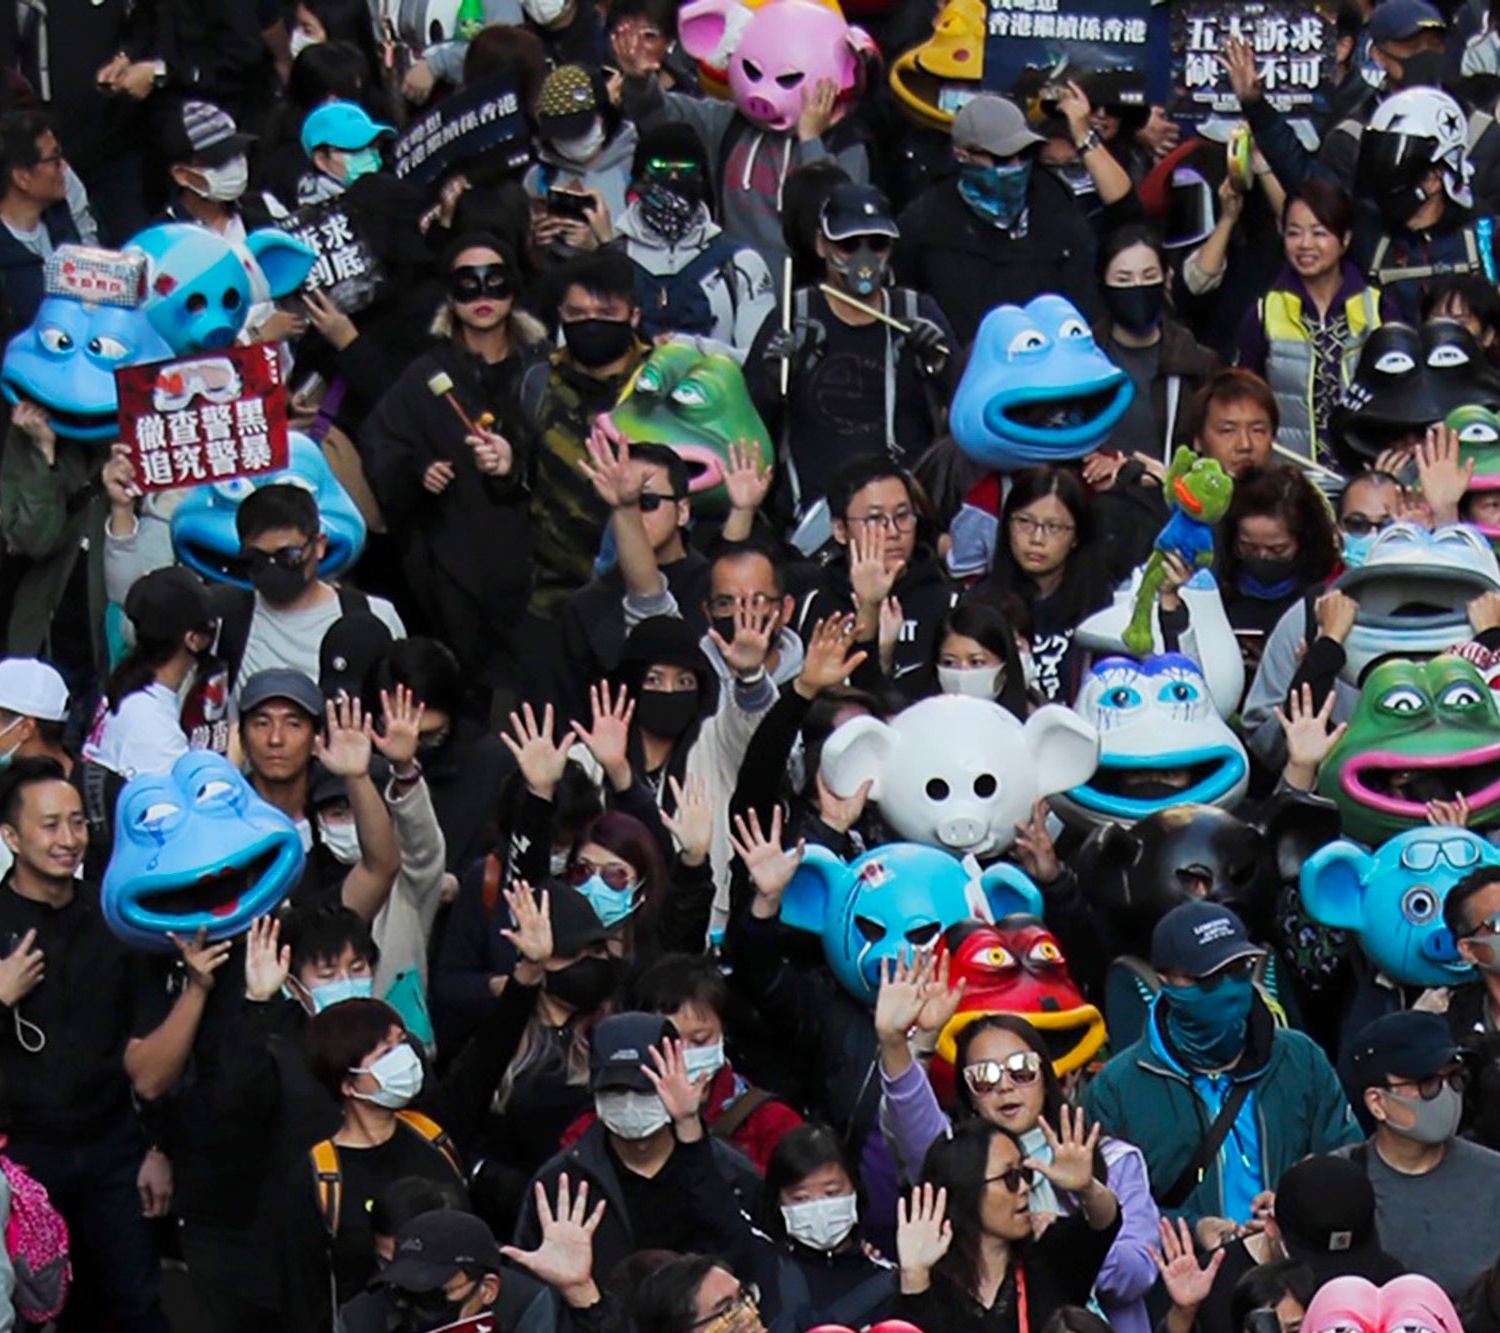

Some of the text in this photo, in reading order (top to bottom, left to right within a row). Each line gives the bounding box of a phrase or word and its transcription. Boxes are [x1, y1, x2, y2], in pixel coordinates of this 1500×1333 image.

[1184, 50, 1323, 90] 缺不可
[136, 398, 268, 453] 徹查警黑
[139, 436, 274, 486] 追究警暴
